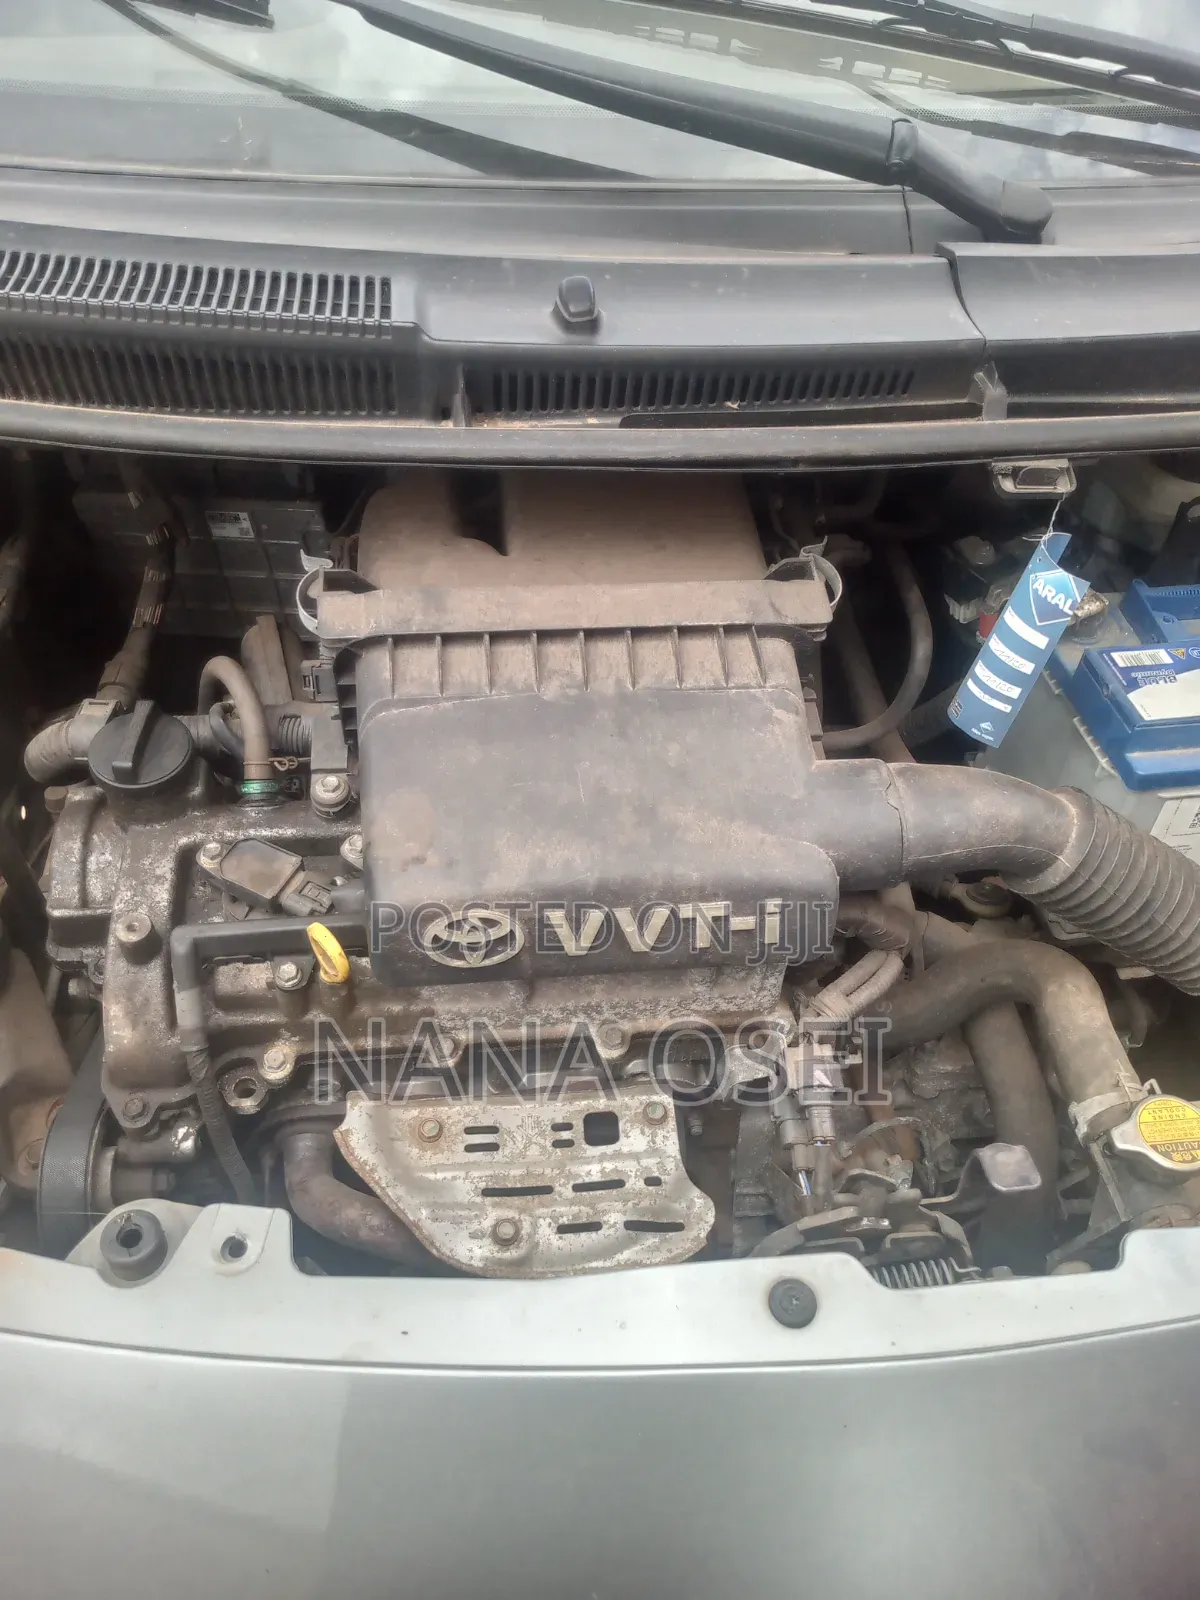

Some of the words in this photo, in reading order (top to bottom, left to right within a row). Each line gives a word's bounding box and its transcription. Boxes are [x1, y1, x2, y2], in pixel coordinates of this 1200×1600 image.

[1032, 577, 1074, 616] ARAL
[1137, 675, 1179, 687] BLUE
[545, 897, 783, 957] VVT-i
[1147, 1106, 1186, 1115] COOLANT
[1151, 1113, 1186, 1121] ENGINE
[1156, 1141, 1200, 1153] AUTION
